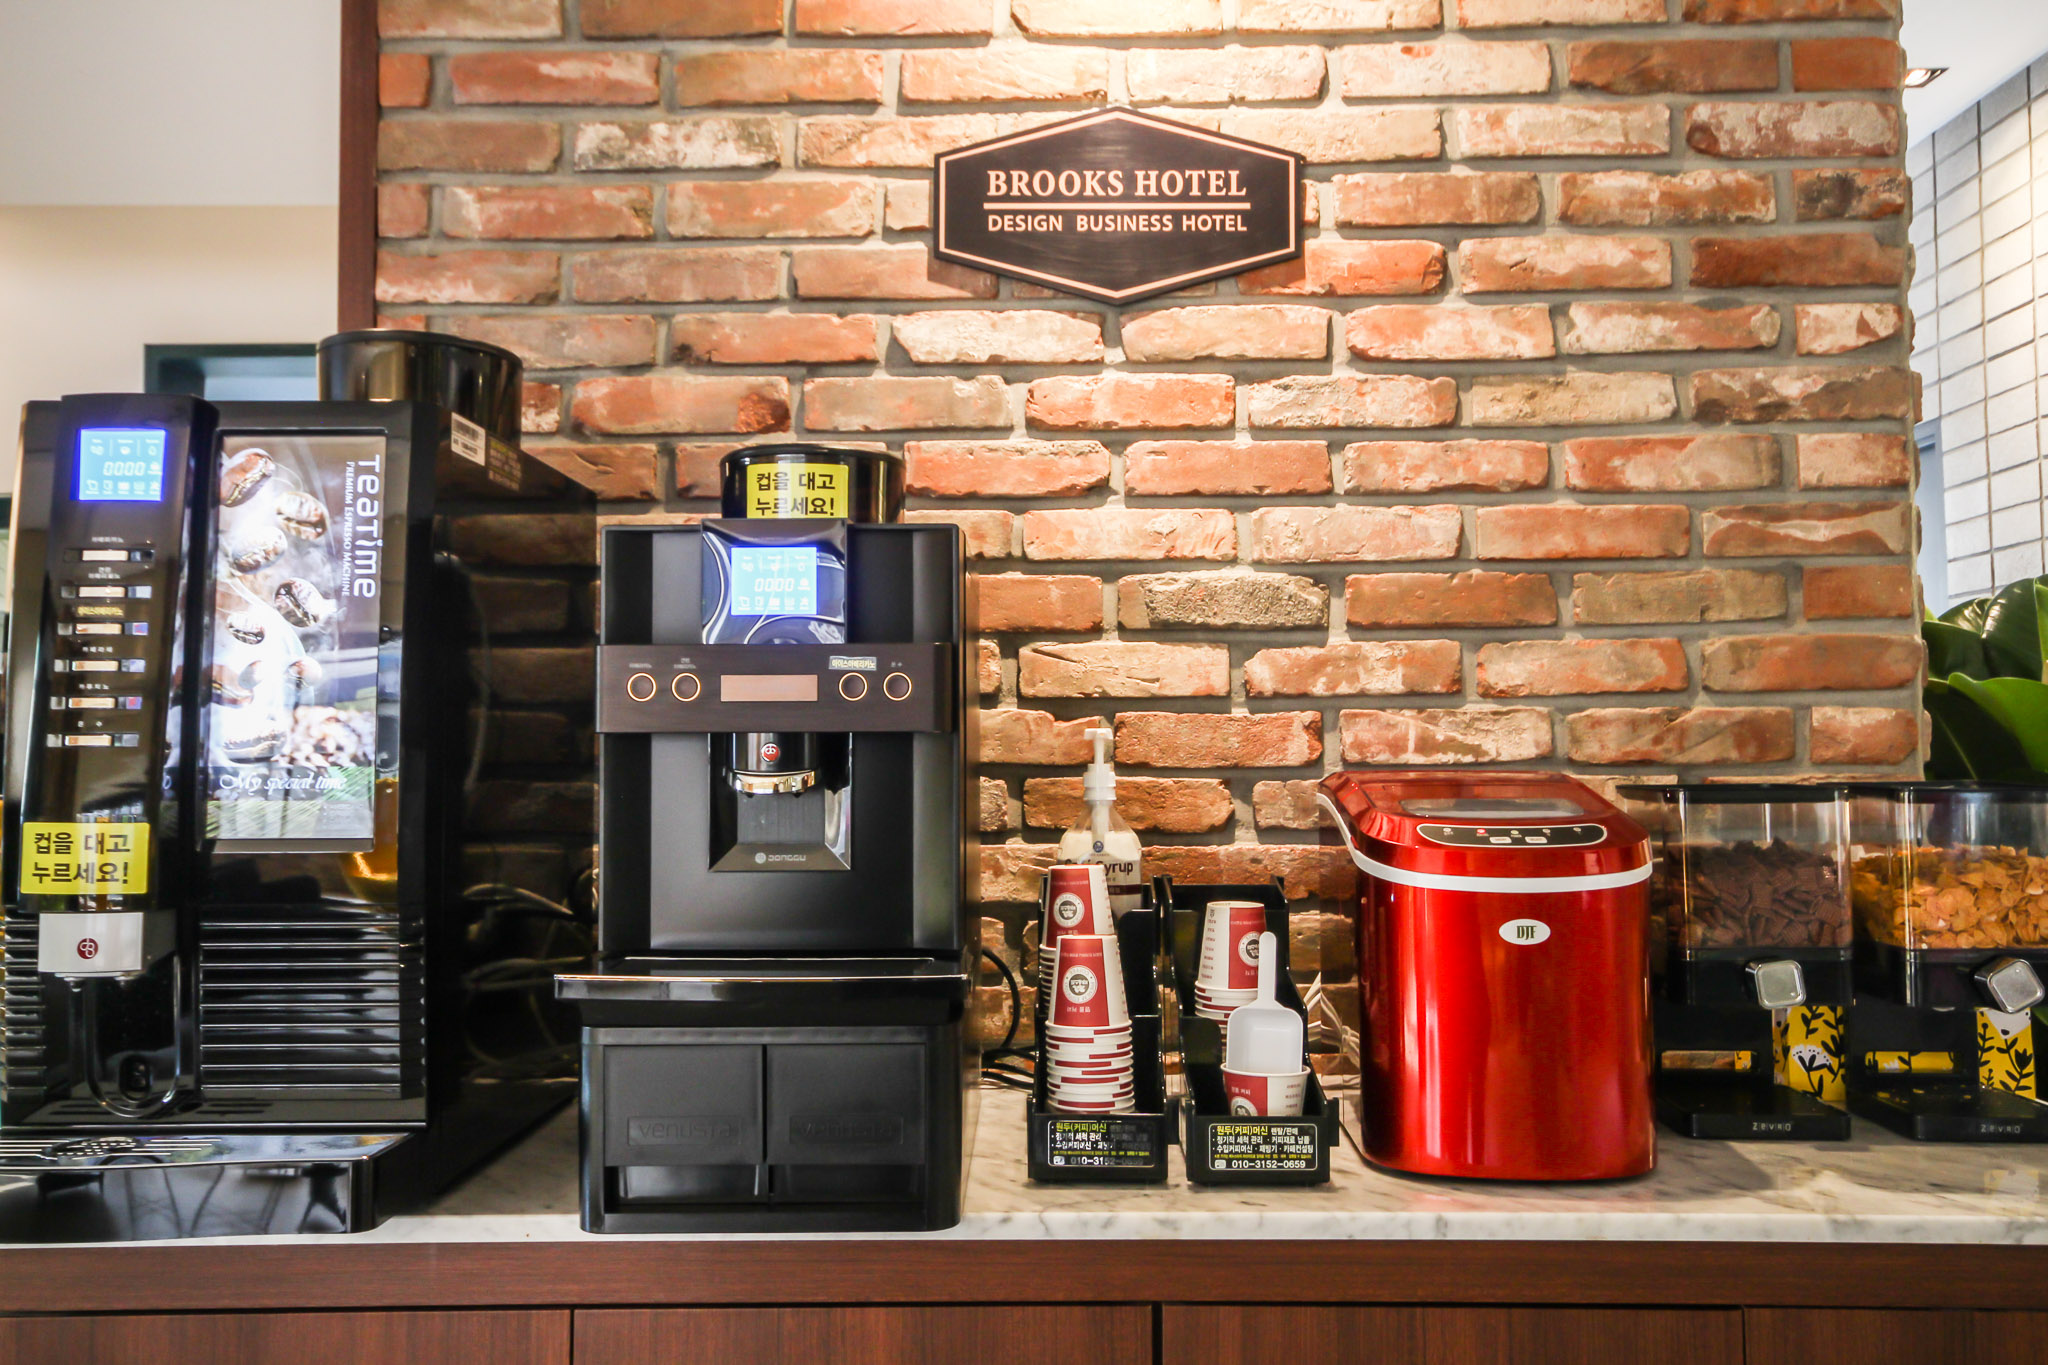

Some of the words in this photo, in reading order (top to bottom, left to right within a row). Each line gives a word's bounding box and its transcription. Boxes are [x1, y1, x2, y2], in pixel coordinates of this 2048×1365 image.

[986, 169, 1125, 197] BROOKS
[1134, 169, 1248, 197] HOTEL
[987, 214, 1063, 232] DESIGN
[1076, 214, 1173, 232] BUSINESS
[1182, 214, 1248, 232] HOTEL
[103, 461, 146, 476] 0000
[345, 461, 355, 504] PREMIUM
[756, 472, 789, 491] 컵을
[799, 472, 835, 490] 대고
[755, 497, 835, 516] 누르세요!
[343, 506, 354, 550] ESPRESSO
[342, 552, 352, 596] MACHINE
[754, 578, 795, 592] 0000
[219, 772, 262, 796] My
[264, 770, 315, 796] special
[34, 832, 74, 855] 컵을
[84, 832, 131, 855] 대고
[32, 861, 129, 884] 누르세요!
[1056, 1122, 1107, 1132] 원두(커피)머신
[1217, 1125, 1268, 1135] 원두(커피)머신
[1216, 1136, 1235, 1144] 정기적
[1231, 1160, 1306, 1169] 010-3152-0659
